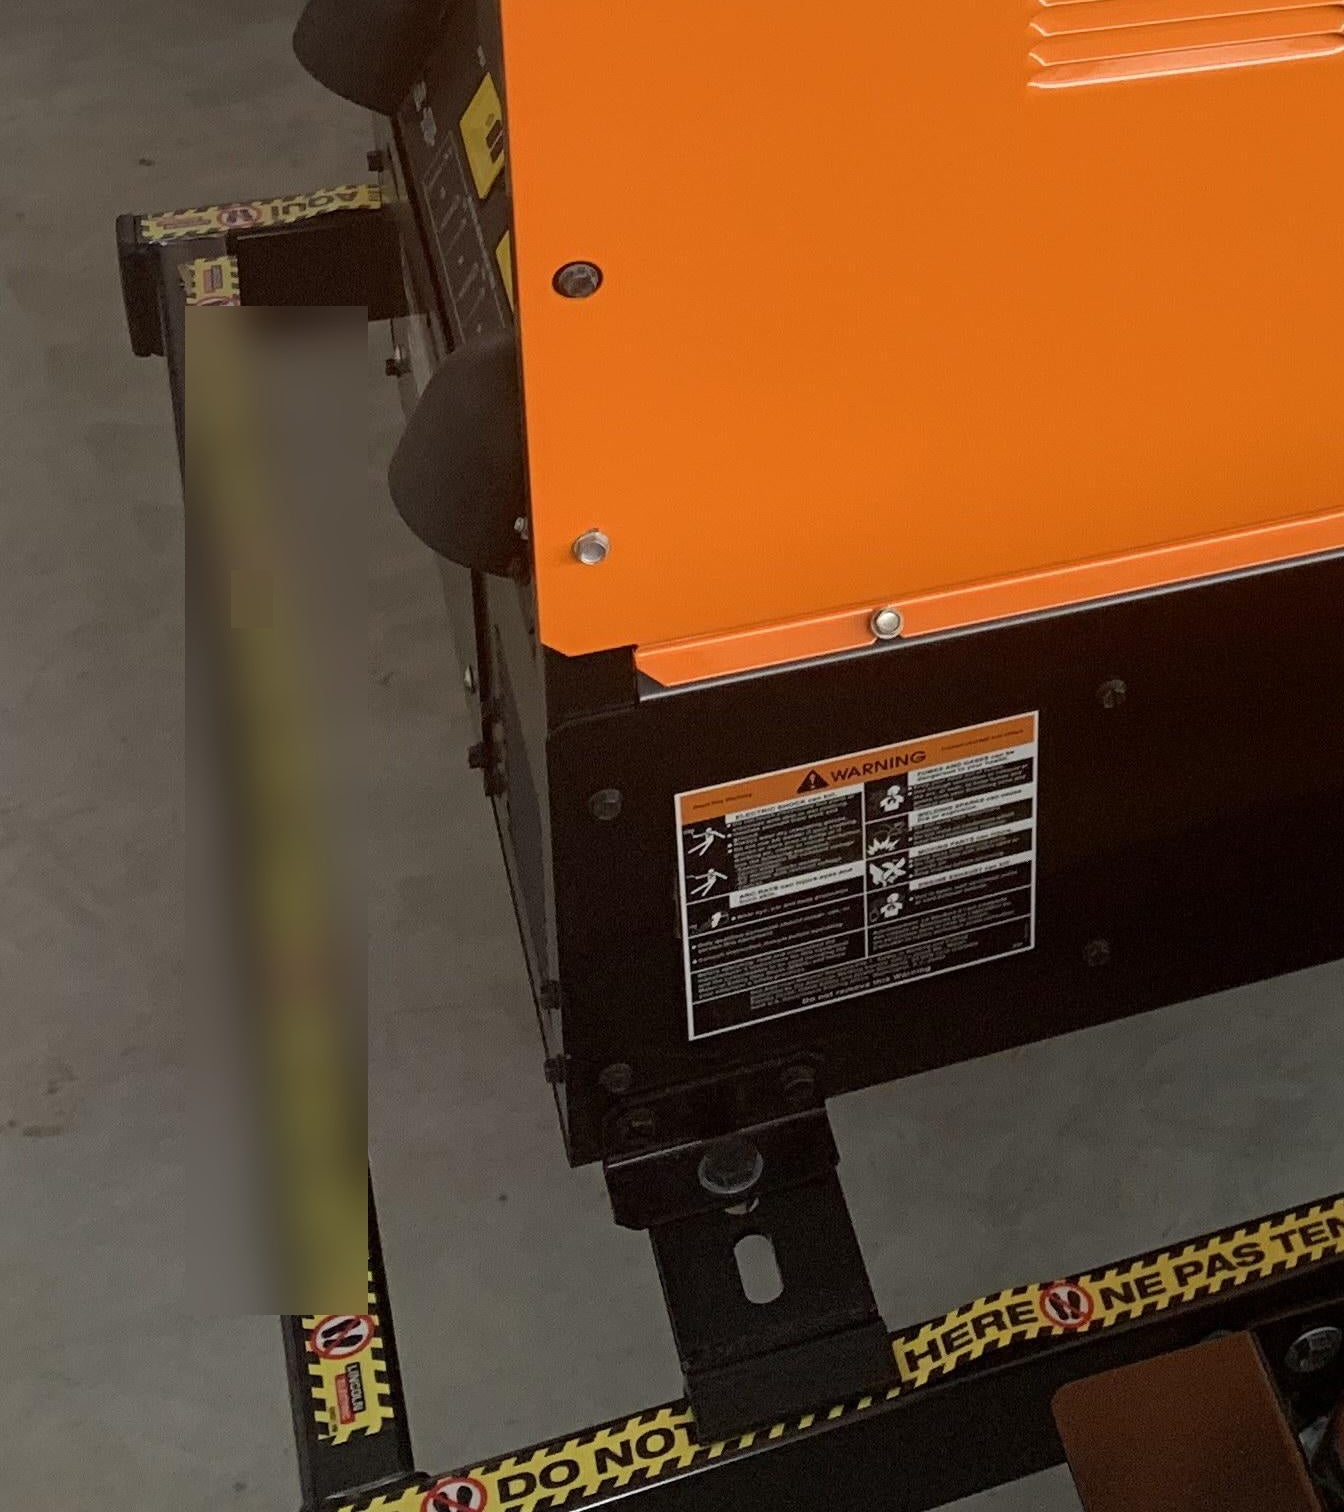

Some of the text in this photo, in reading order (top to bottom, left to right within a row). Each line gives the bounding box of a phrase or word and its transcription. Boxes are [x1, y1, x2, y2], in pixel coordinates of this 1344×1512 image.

[831, 749, 927, 783] WARNING
[1099, 1272, 1164, 1311] NE
[1173, 1242, 1265, 1288] PAS
[347, 1364, 364, 1412] LINCOLN
[497, 1459, 580, 1503] DO
[904, 1300, 1039, 1371] HERE
